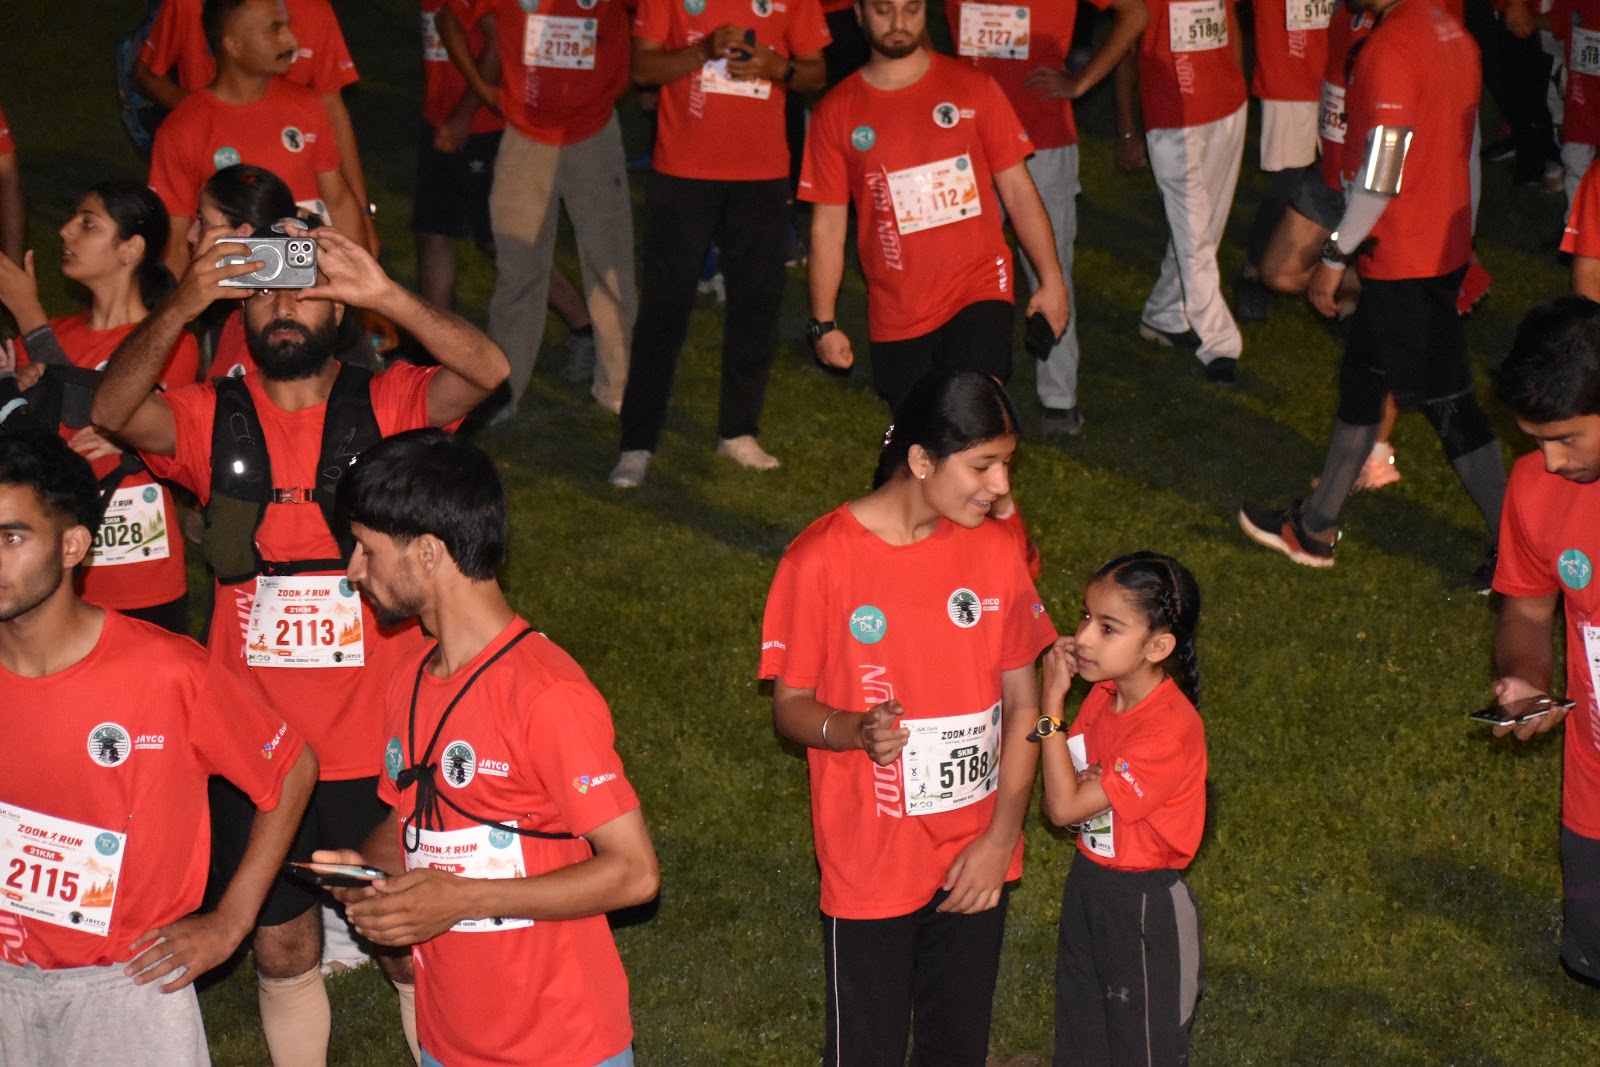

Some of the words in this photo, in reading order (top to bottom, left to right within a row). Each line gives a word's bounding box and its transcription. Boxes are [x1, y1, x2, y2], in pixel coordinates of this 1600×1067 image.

[978, 29, 1011, 45] 2127
[1189, 23, 1219, 38] 5189
[545, 40, 580, 57] 2128
[865, 172, 892, 212] RUN
[877, 220, 903, 270] ZOON
[118, 498, 133, 507] RUN
[277, 589, 302, 597] ZOON
[311, 589, 331, 597] RUN
[851, 613, 874, 624] Snow
[276, 619, 335, 646] 2113
[134, 735, 165, 744] JAYCO
[941, 730, 965, 740] ZOON
[972, 724, 987, 735] RUN
[271, 733, 281, 750] J&K
[957, 748, 973, 757] 5KM
[478, 758, 509, 772] JAYCO
[939, 751, 988, 789] 5188
[590, 776, 606, 787] J&K
[605, 773, 618, 783] Bank
[1121, 772, 1135, 785] J&K
[1133, 781, 1144, 799] Bank
[17, 824, 48, 838] ZOON
[58, 835, 83, 847] RUN
[29, 847, 56, 859] 21KM
[419, 843, 442, 854] ZOON
[453, 843, 477, 854] RUN
[434, 864, 456, 873] 21KM
[6, 858, 80, 902] 2115
[84, 917, 106, 927] JAYCO
